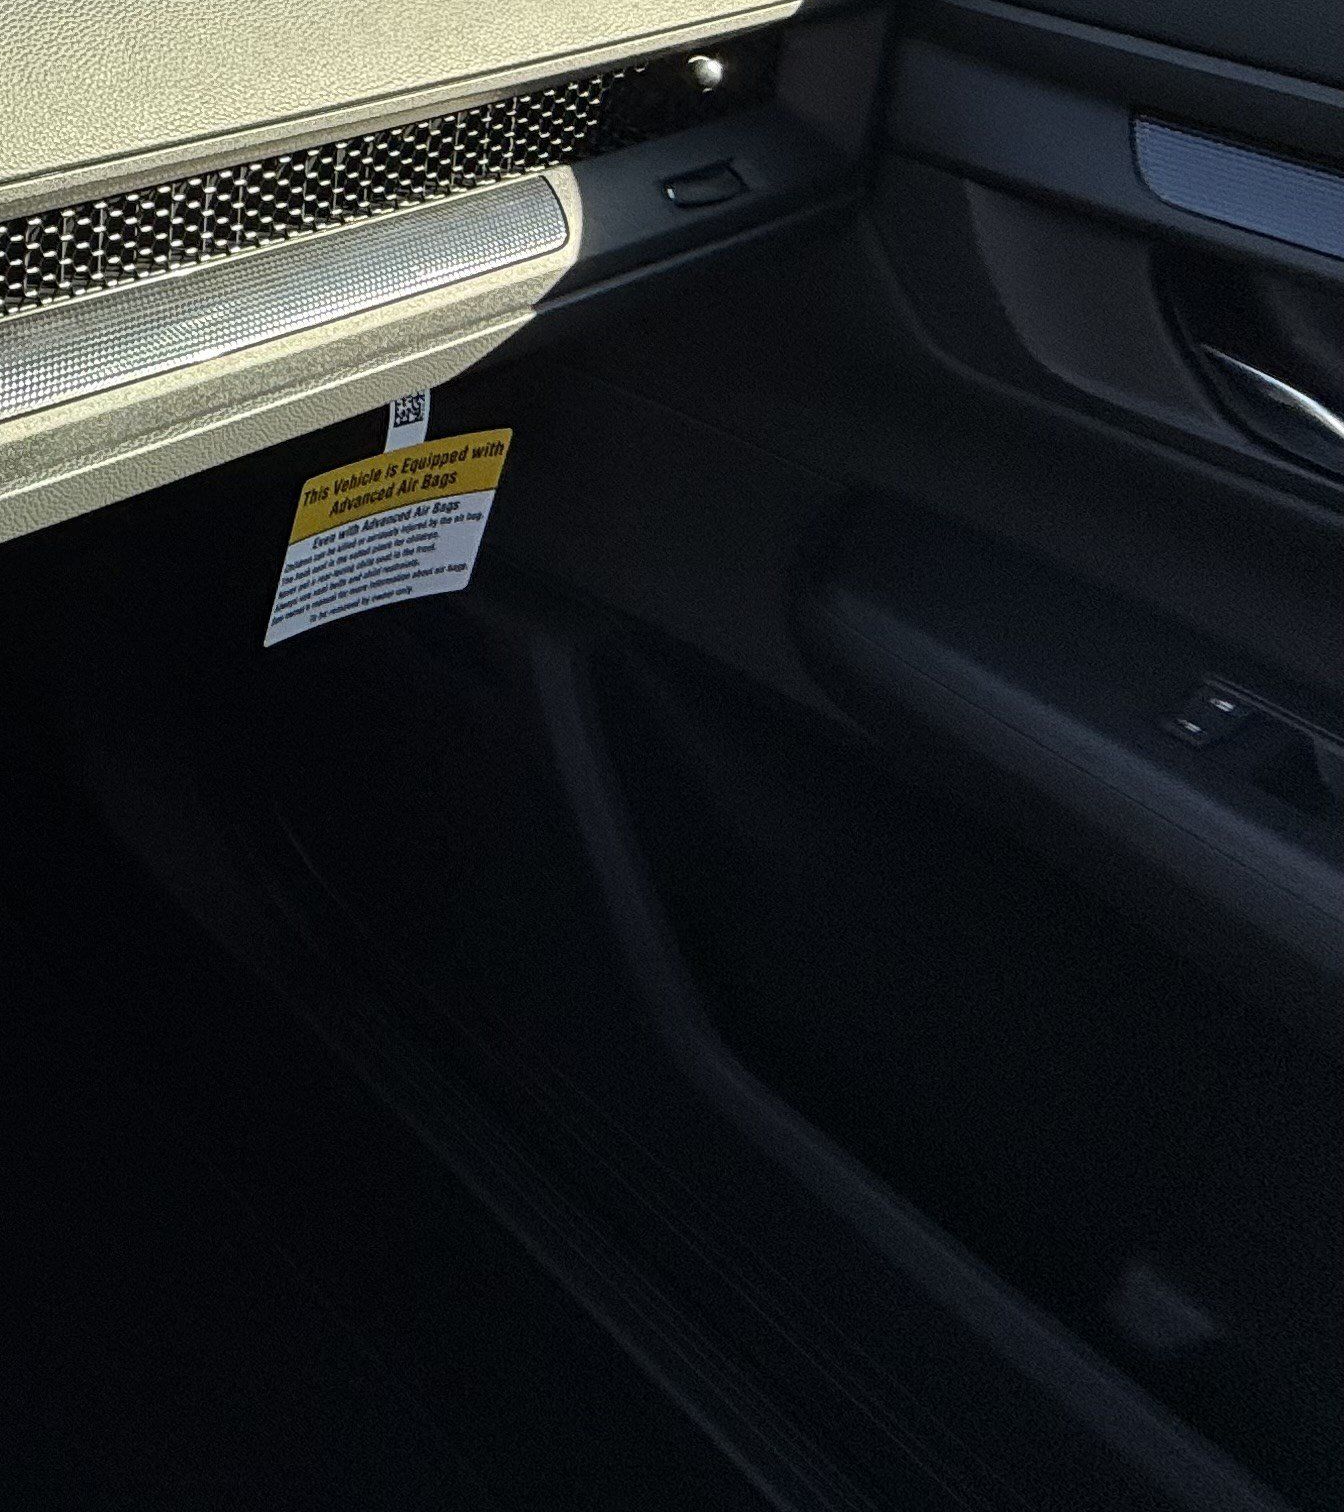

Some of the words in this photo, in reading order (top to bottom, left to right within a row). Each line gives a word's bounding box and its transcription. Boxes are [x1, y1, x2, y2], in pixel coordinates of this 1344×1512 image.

[303, 486, 329, 507] This
[333, 468, 381, 497] Vehicle
[401, 444, 469, 473] Equipped
[472, 440, 505, 460] with
[329, 484, 394, 517] Advanced
[394, 478, 417, 497] Air
[421, 470, 457, 490] Bags
[413, 506, 431, 518] Air
[432, 501, 461, 514] Bags
